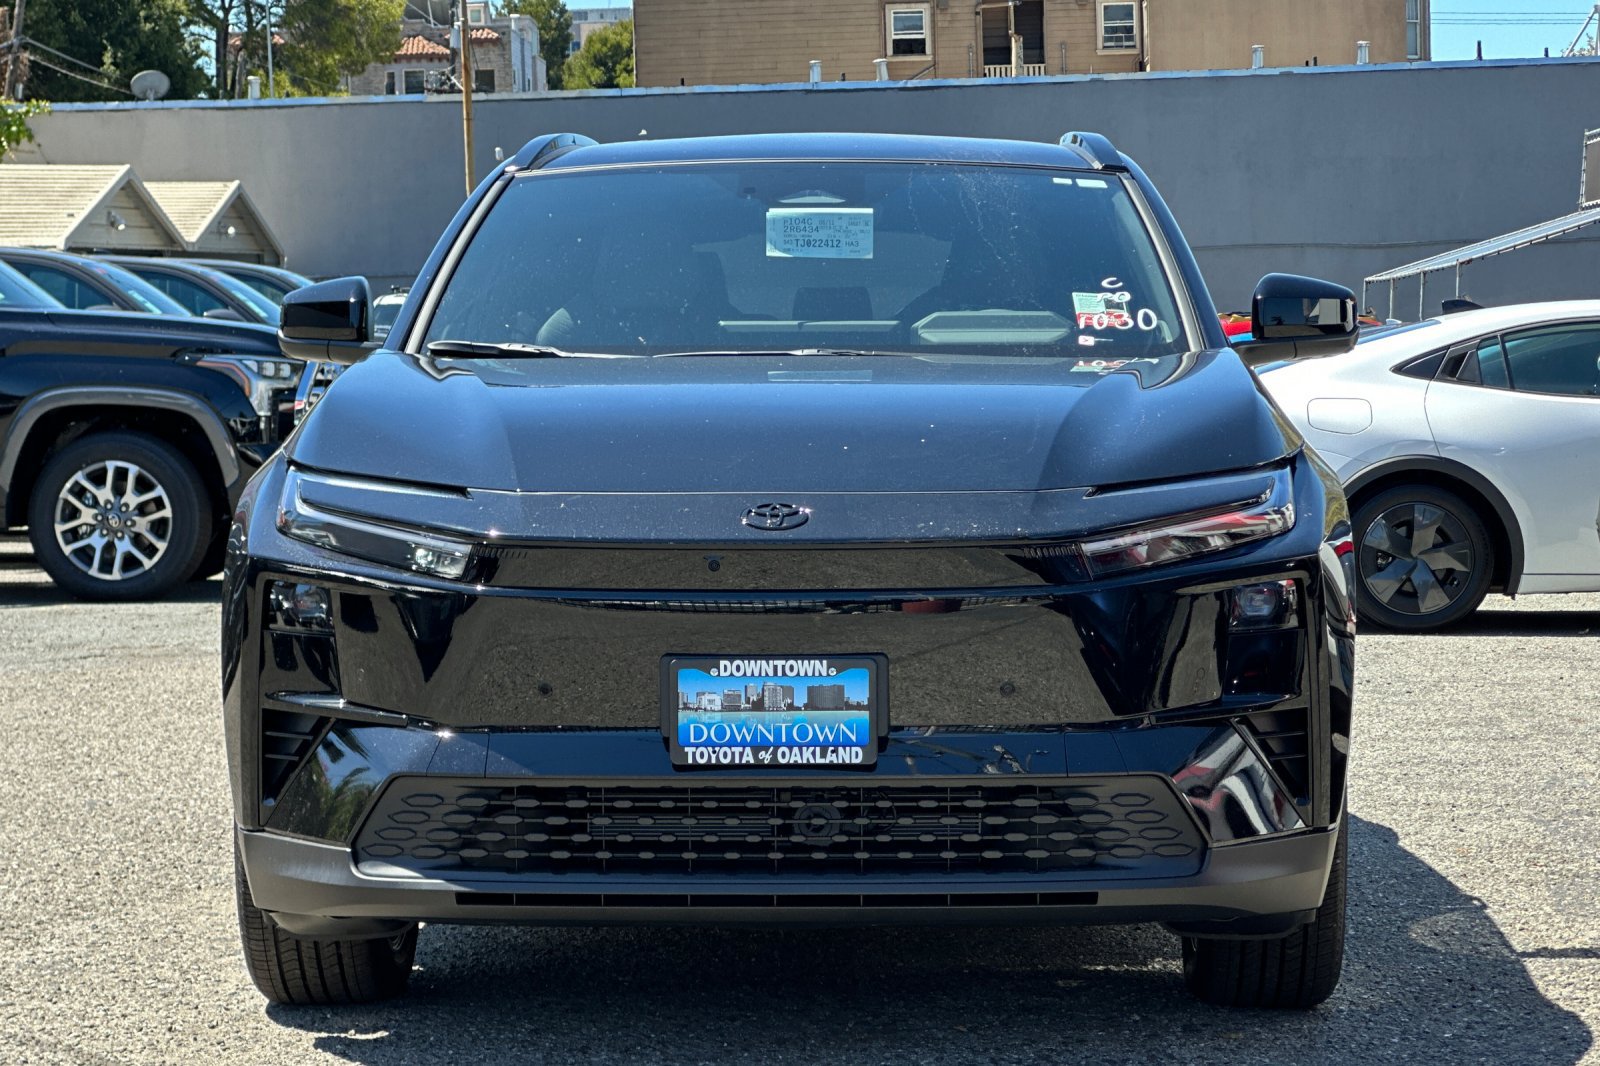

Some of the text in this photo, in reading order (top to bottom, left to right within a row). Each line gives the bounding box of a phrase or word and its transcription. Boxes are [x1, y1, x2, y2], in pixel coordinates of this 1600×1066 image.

[719, 660, 828, 677] DOWNTOWN
[689, 722, 857, 743] DOWNTOWN
[684, 746, 863, 764] TOYOTA of OAKLAND
